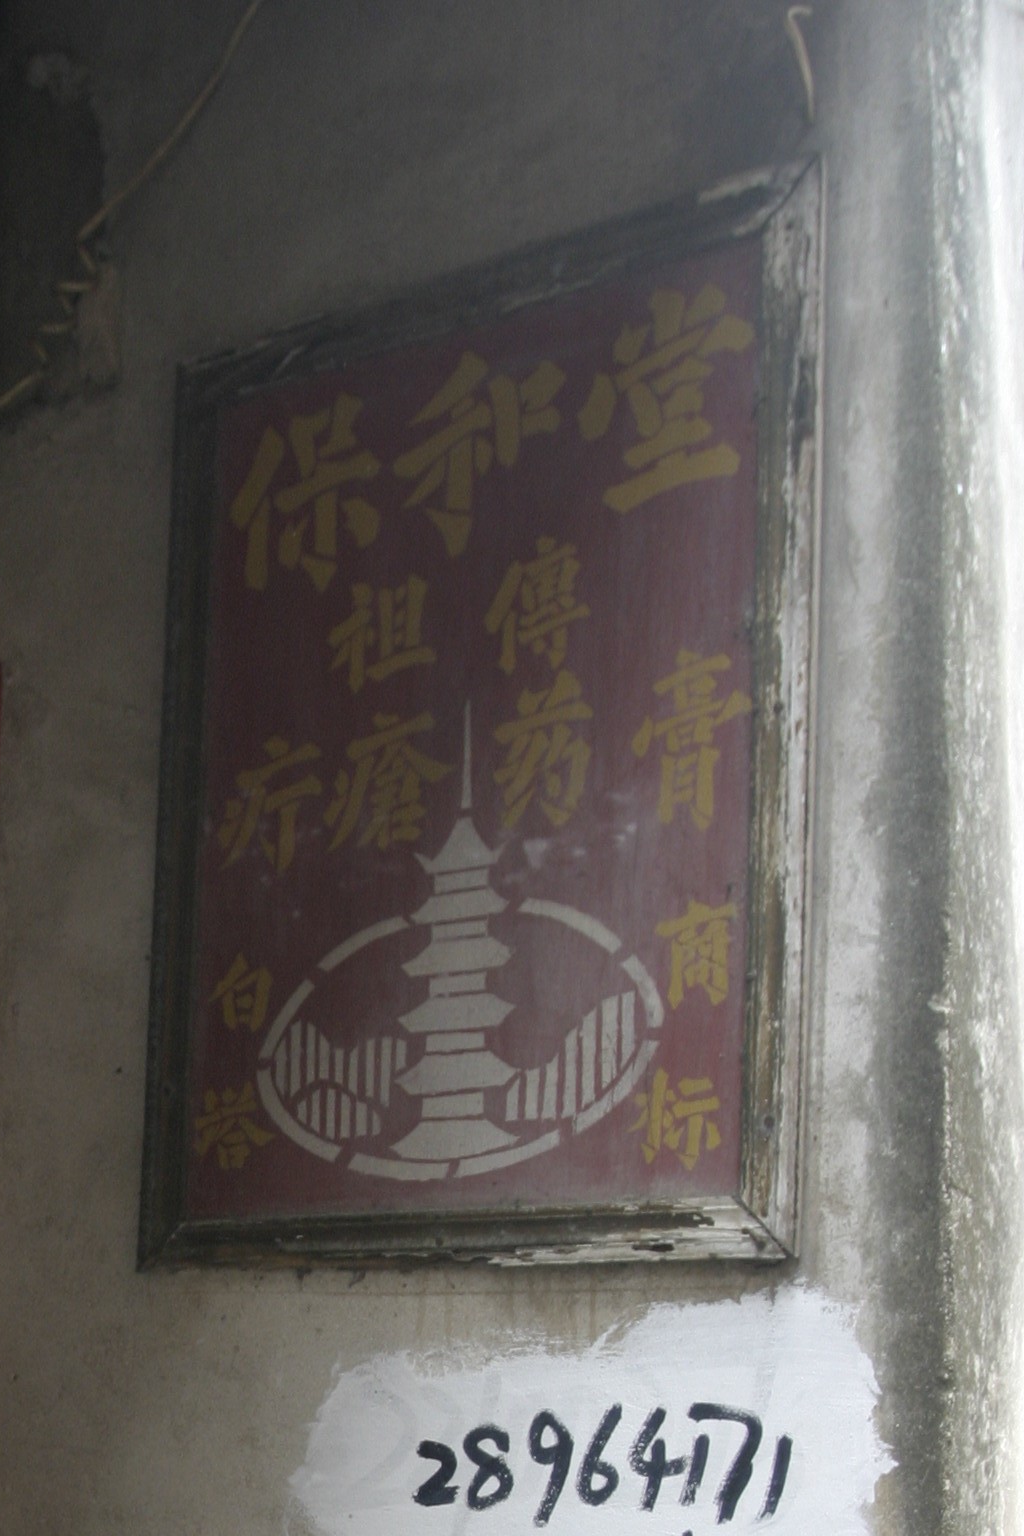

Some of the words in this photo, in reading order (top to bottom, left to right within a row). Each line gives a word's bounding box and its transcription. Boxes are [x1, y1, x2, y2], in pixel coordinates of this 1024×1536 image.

[230, 284, 756, 594] 保和堂
[411, 1401, 794, 1530] 28964171
